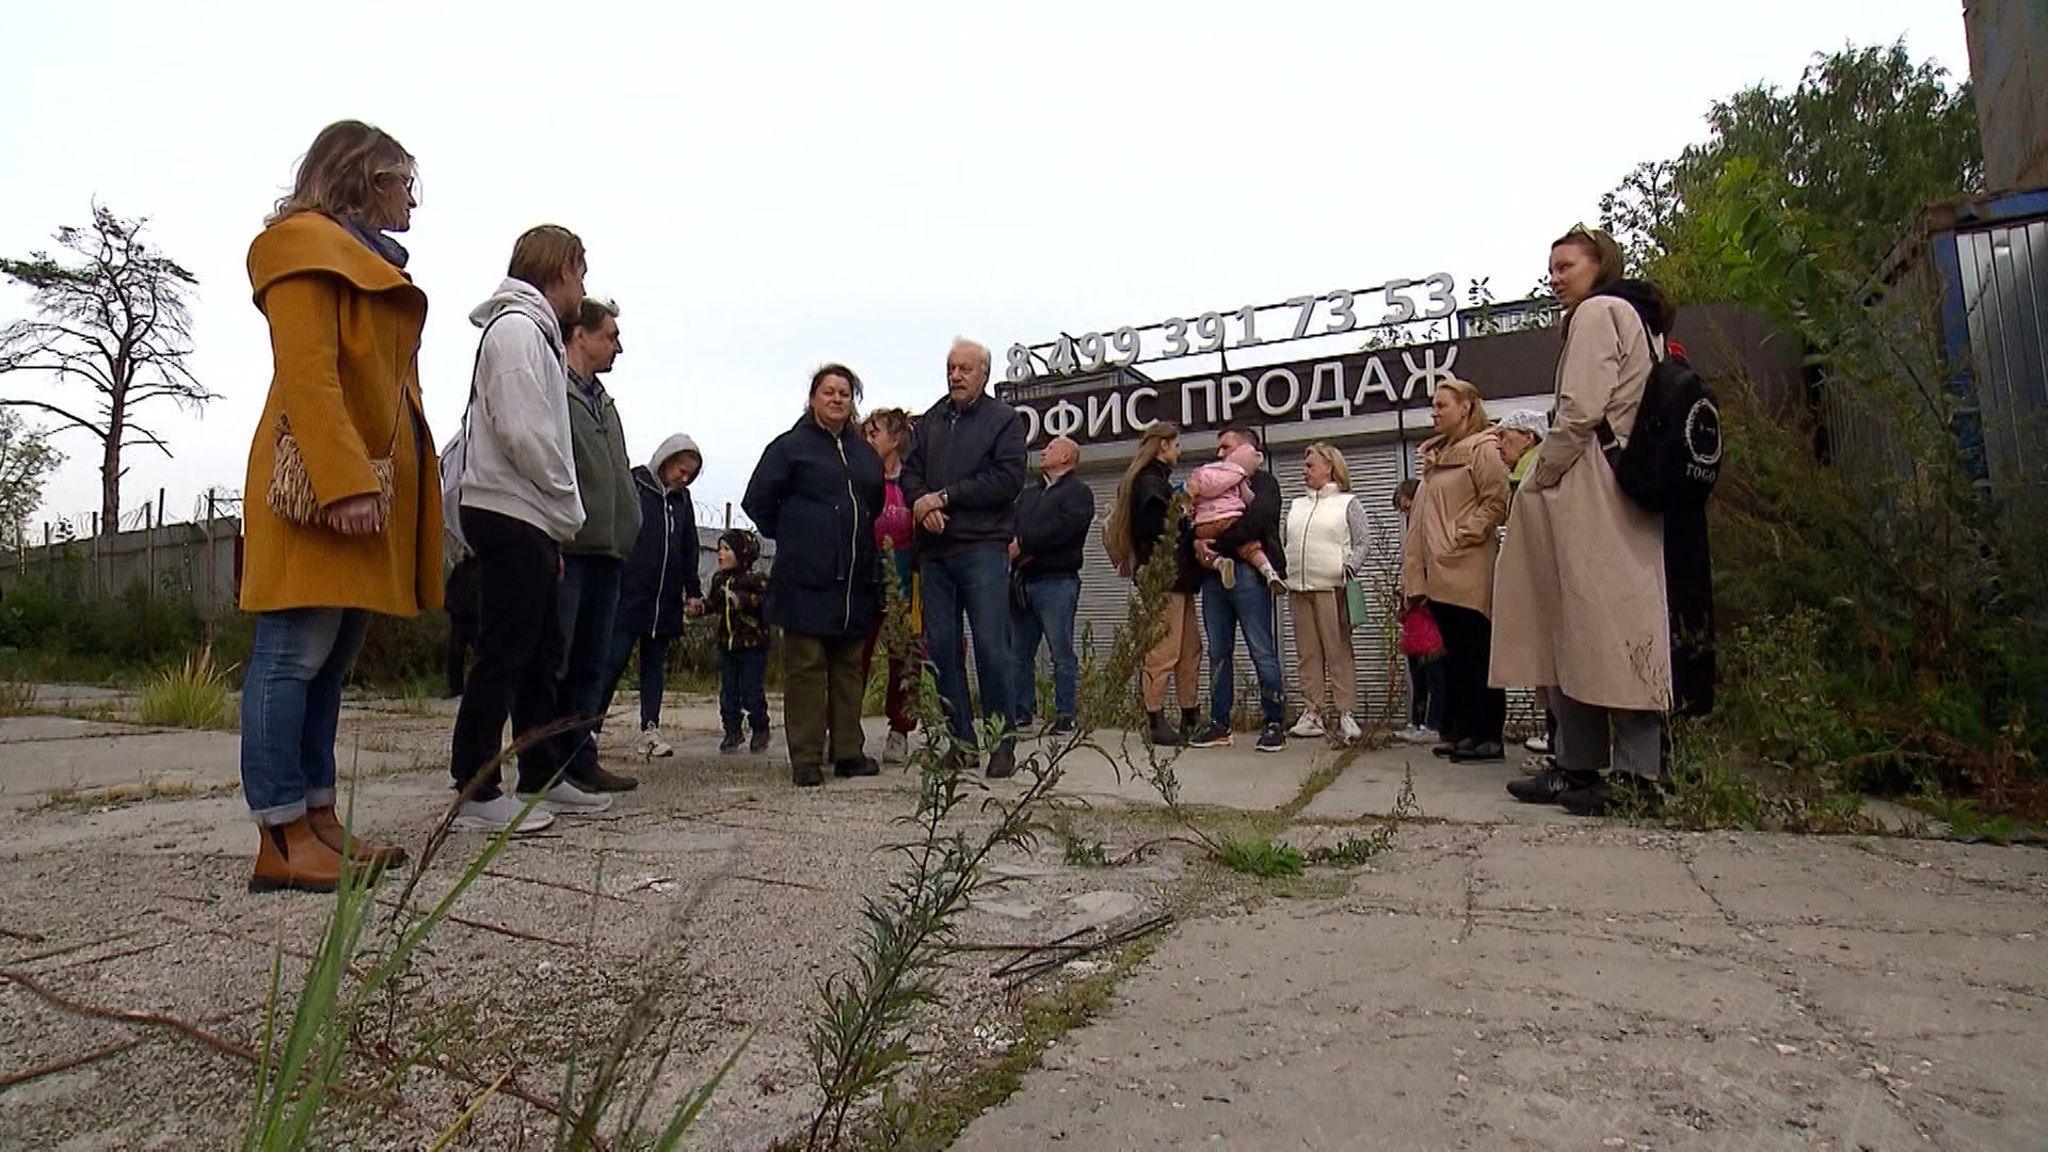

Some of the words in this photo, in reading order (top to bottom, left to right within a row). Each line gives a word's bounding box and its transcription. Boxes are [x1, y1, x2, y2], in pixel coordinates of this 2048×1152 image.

[1007, 344, 1030, 382] 8
[1048, 326, 1140, 376] 499
[1162, 305, 1263, 357] 391
[1287, 289, 1357, 338] 73
[1384, 272, 1457, 323] 53
[1181, 347, 1459, 425] ПРОДАЖ
